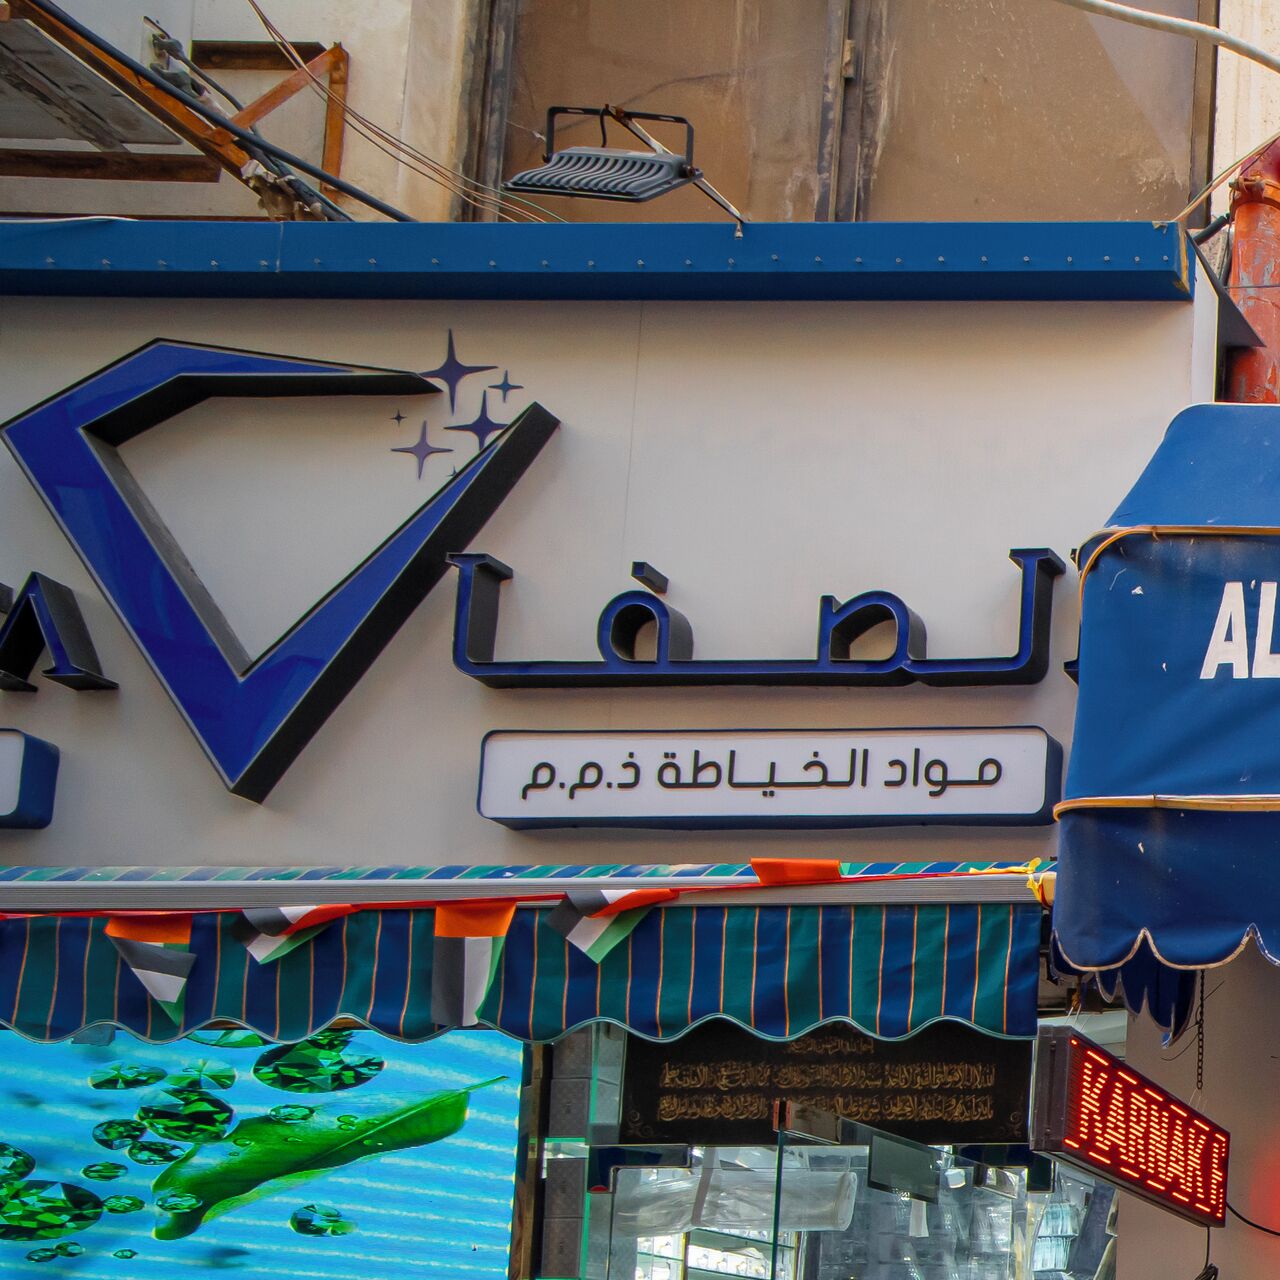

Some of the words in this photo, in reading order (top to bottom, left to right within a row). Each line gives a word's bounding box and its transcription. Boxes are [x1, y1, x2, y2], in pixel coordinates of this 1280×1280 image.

[656, 747, 870, 799] الخياطة
[884, 747, 1003, 798] مواد
[1079, 1062, 1207, 1199] KARNAK
